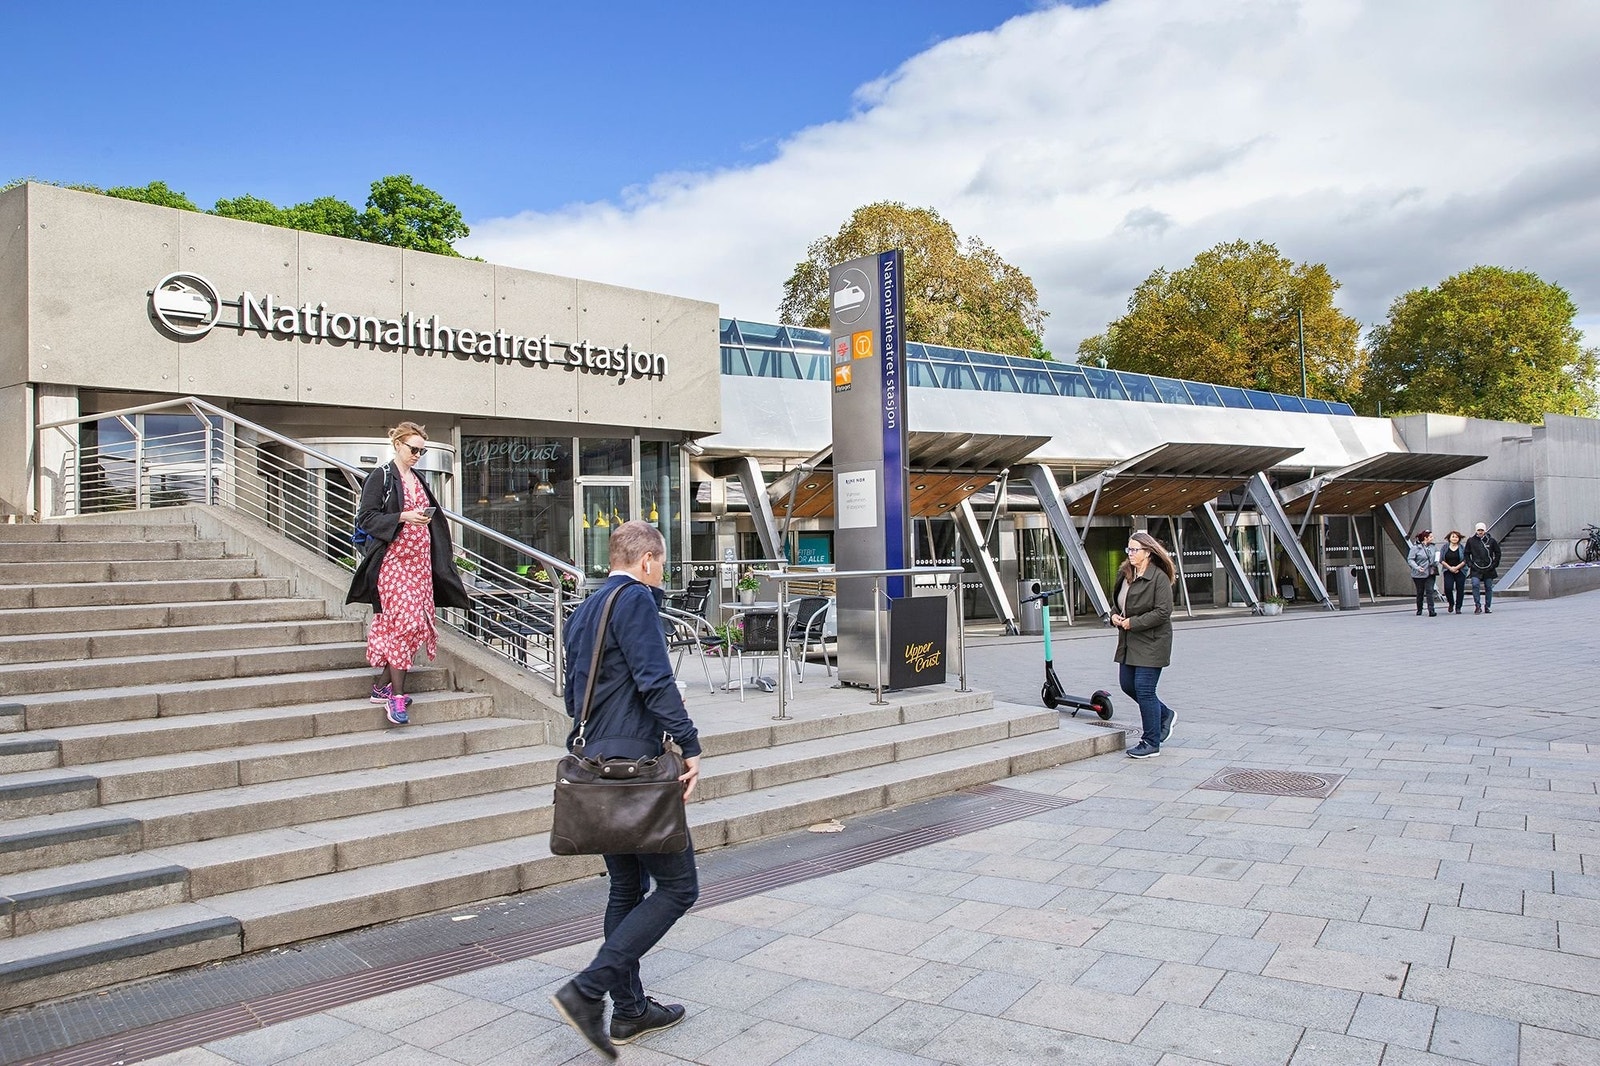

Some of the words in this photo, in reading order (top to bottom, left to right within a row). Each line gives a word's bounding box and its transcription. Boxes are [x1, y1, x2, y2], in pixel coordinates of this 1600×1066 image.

[884, 260, 895, 376] Nationaltheatret
[243, 291, 554, 363] Nationaltheatret
[569, 339, 669, 379] stasjon
[886, 379, 898, 429] stasjon
[463, 440, 519, 466] Upper
[511, 441, 561, 463] Crust
[798, 555, 808, 563] OR
[808, 555, 825, 563] ALLE
[905, 641, 934, 664] Upper
[915, 650, 941, 673] Crust
